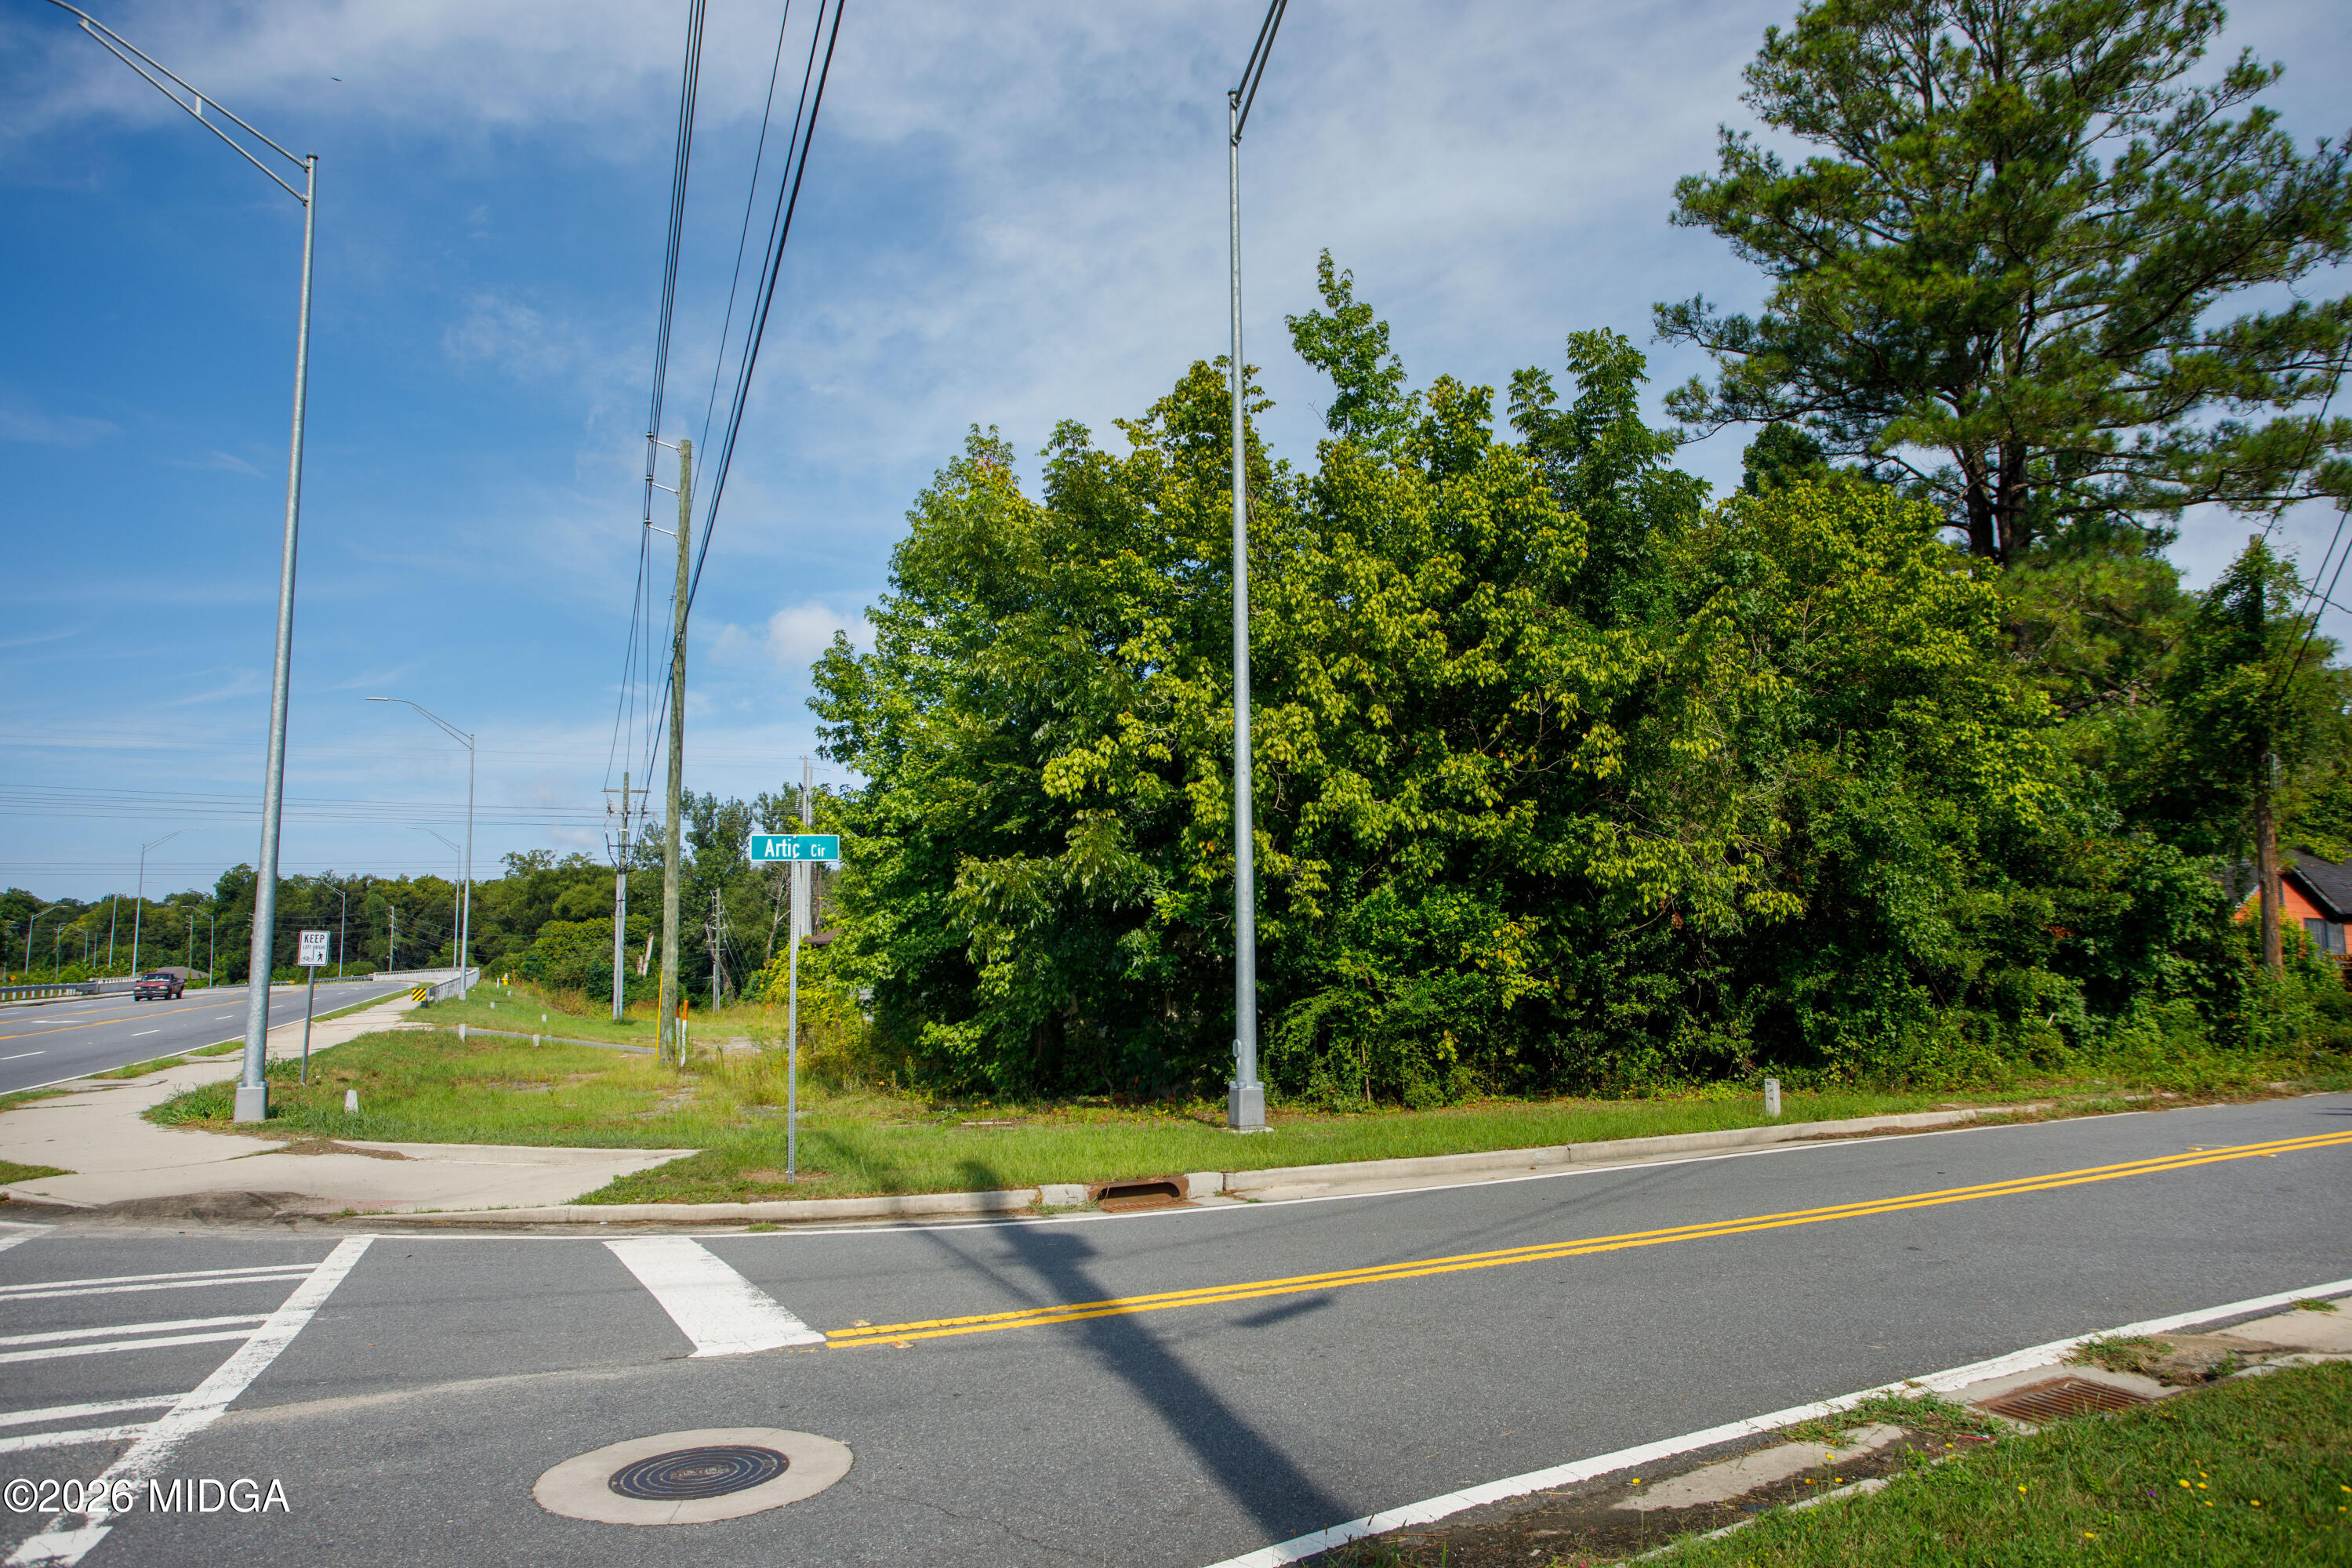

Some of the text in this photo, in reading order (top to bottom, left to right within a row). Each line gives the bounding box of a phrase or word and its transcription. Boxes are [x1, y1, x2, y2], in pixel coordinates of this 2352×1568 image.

[764, 838, 826, 858] Artic Cir
[304, 934, 325, 944] KEEP
